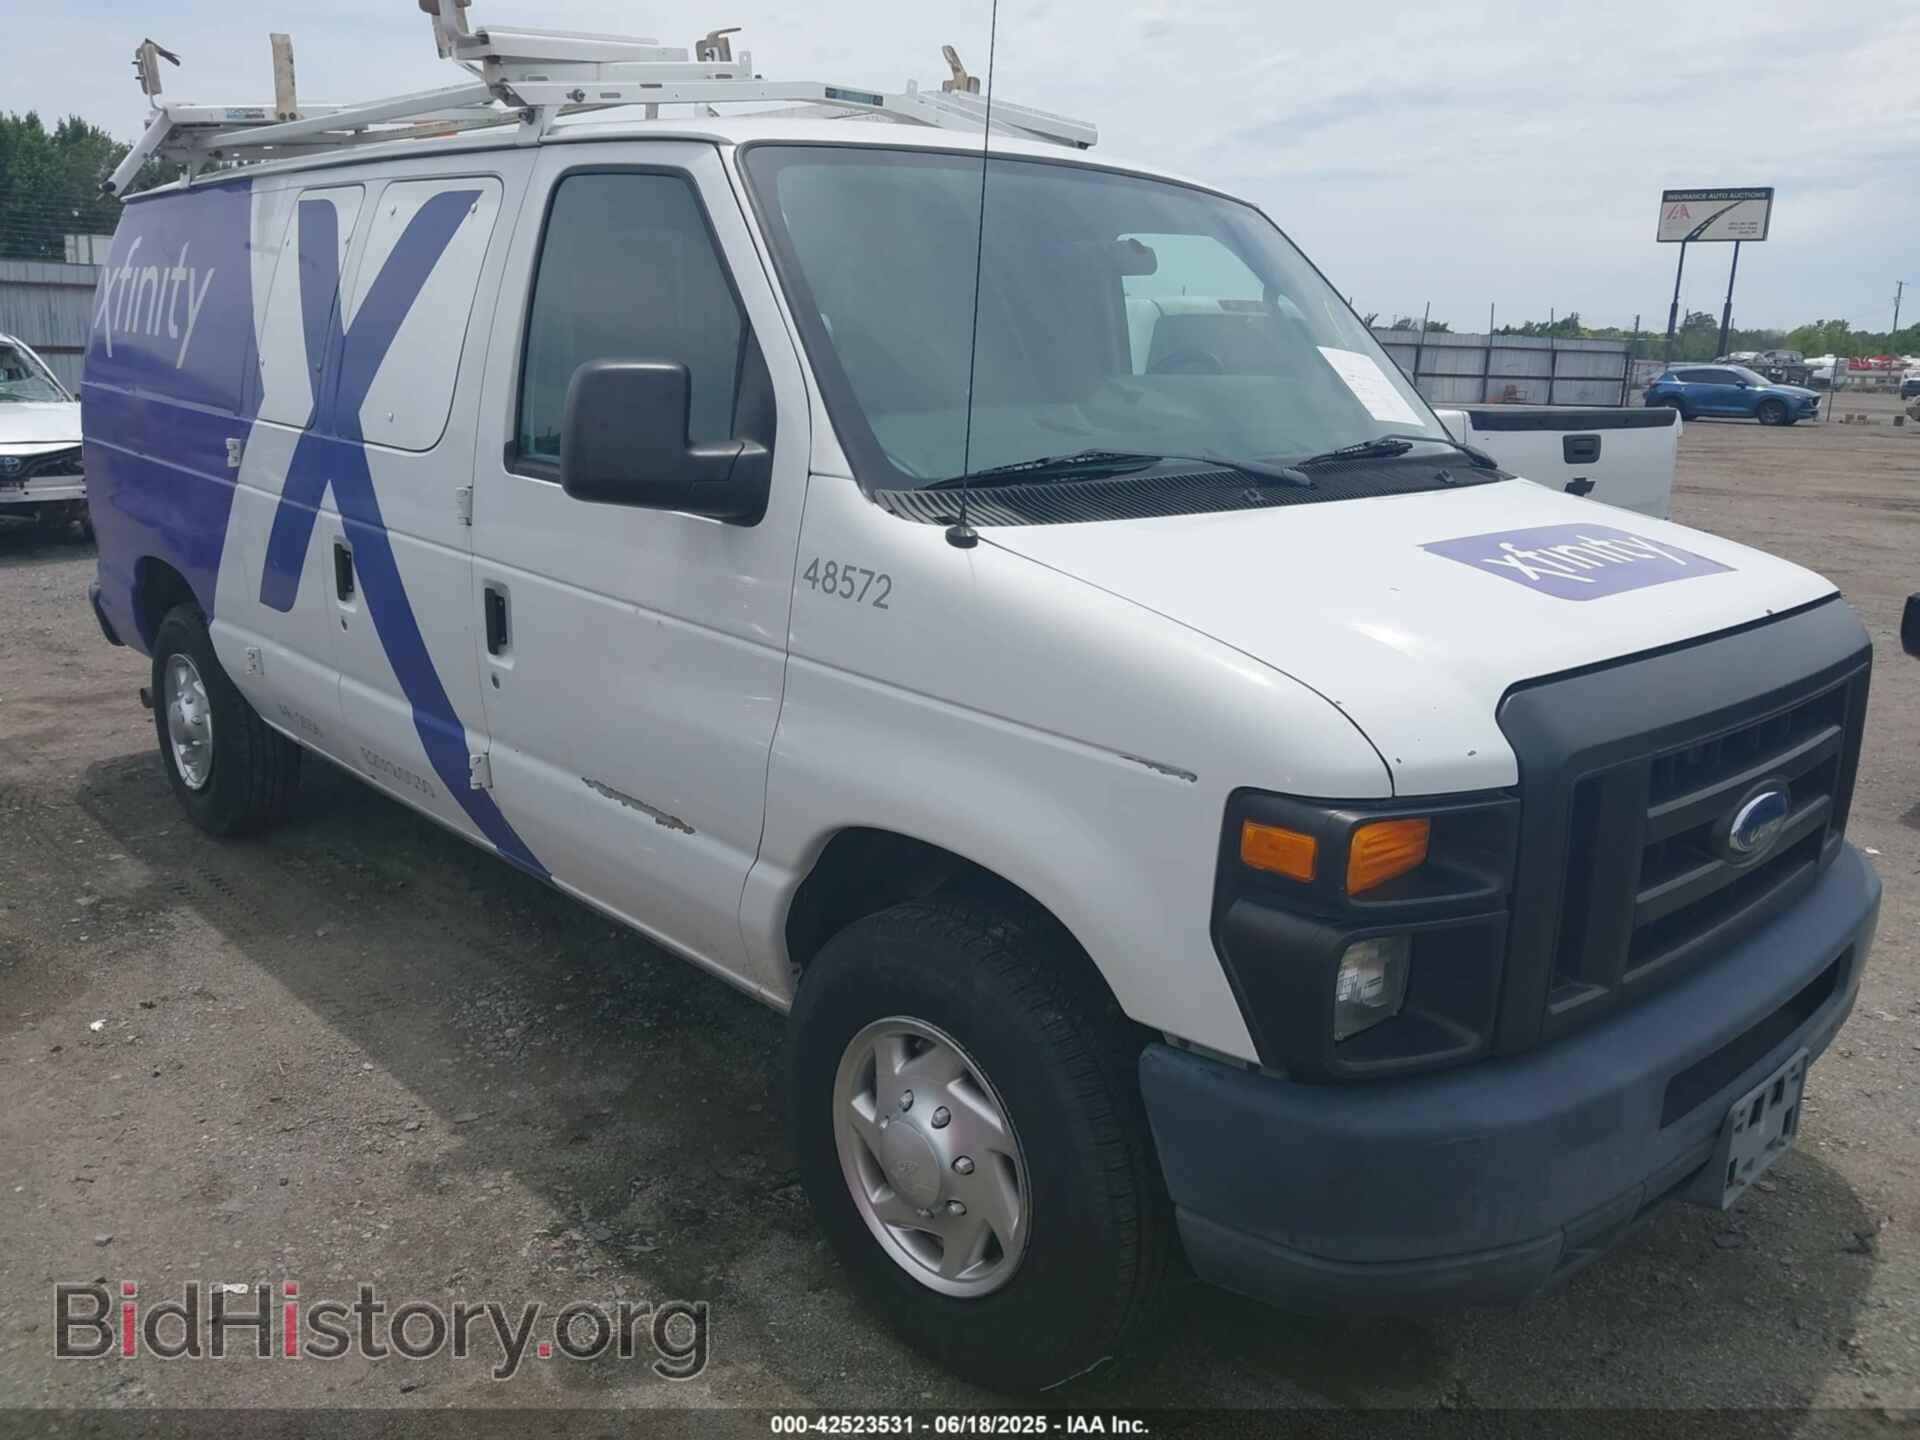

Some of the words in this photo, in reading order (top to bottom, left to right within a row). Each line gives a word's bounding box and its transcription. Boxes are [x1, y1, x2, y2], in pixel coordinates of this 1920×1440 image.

[94, 236, 215, 369] xfinity
[803, 557, 892, 610] 48572
[1480, 534, 1688, 583] xfinity
